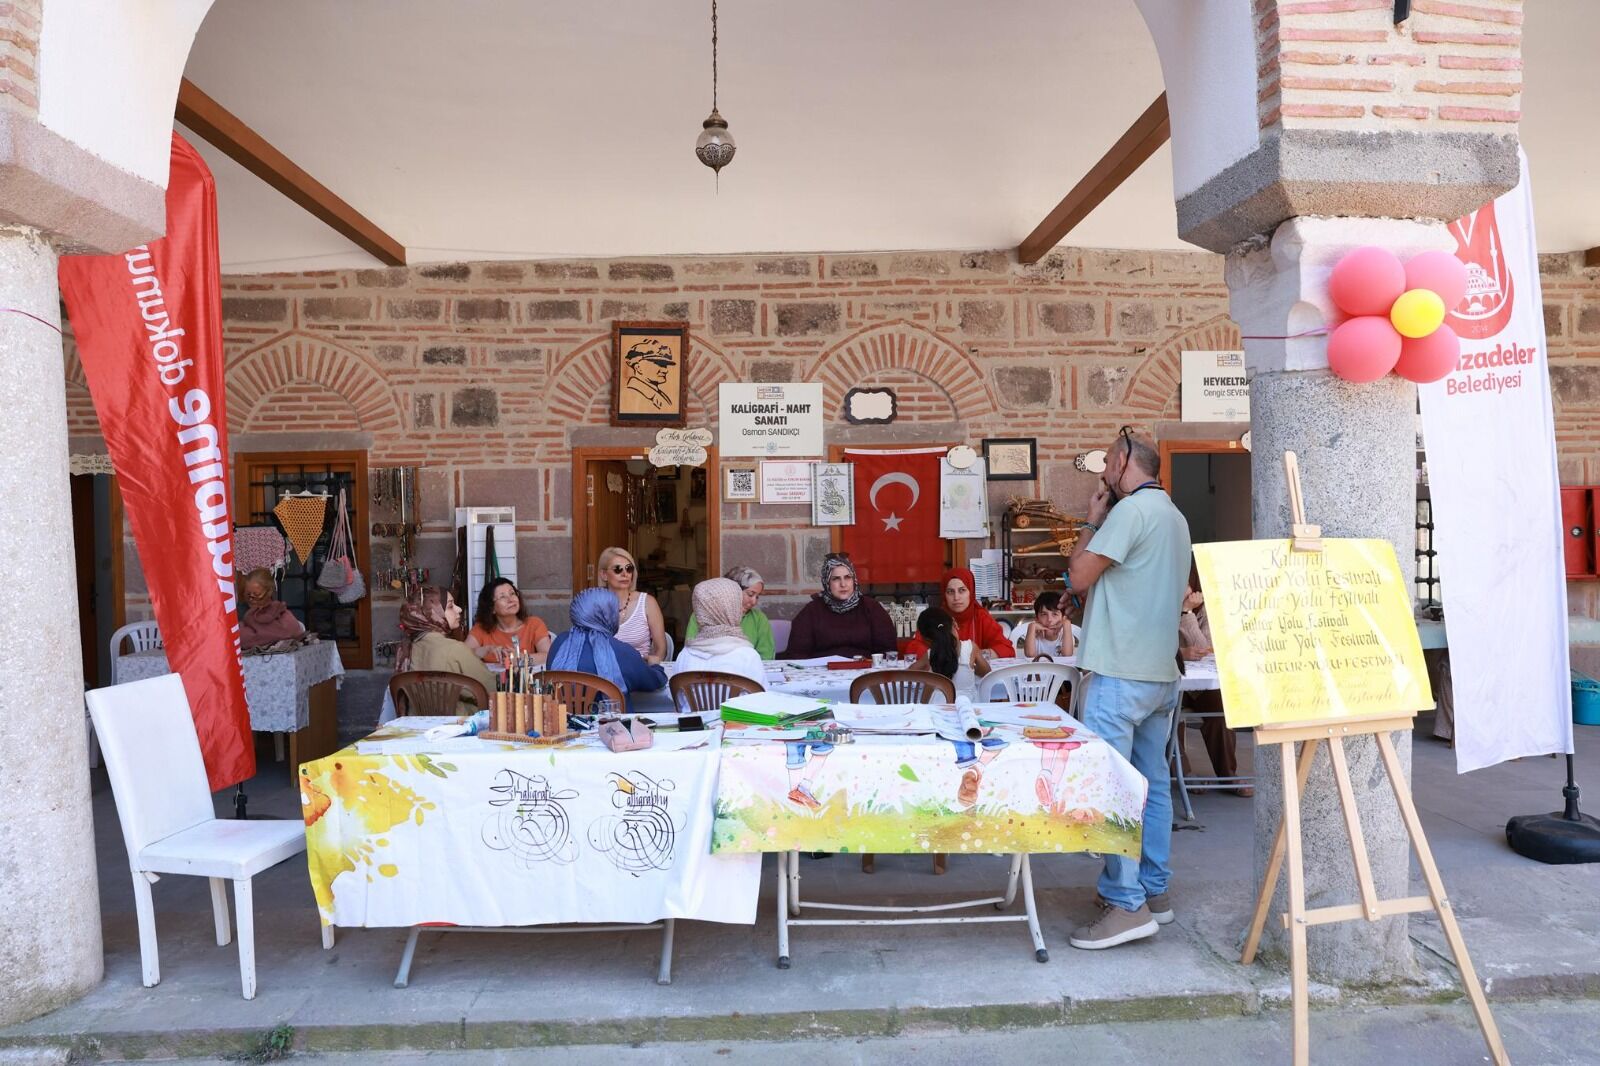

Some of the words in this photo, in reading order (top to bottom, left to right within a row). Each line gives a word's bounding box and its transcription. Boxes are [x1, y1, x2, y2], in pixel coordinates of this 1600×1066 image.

[1447, 371, 1522, 395] Belediyesi
[1204, 389, 1225, 398] Cengiz
[731, 402, 778, 414] KALİGRAFİ
[786, 404, 811, 414] NAHT
[754, 416, 787, 425] SANATI
[768, 429, 800, 437] SANDIKÇI
